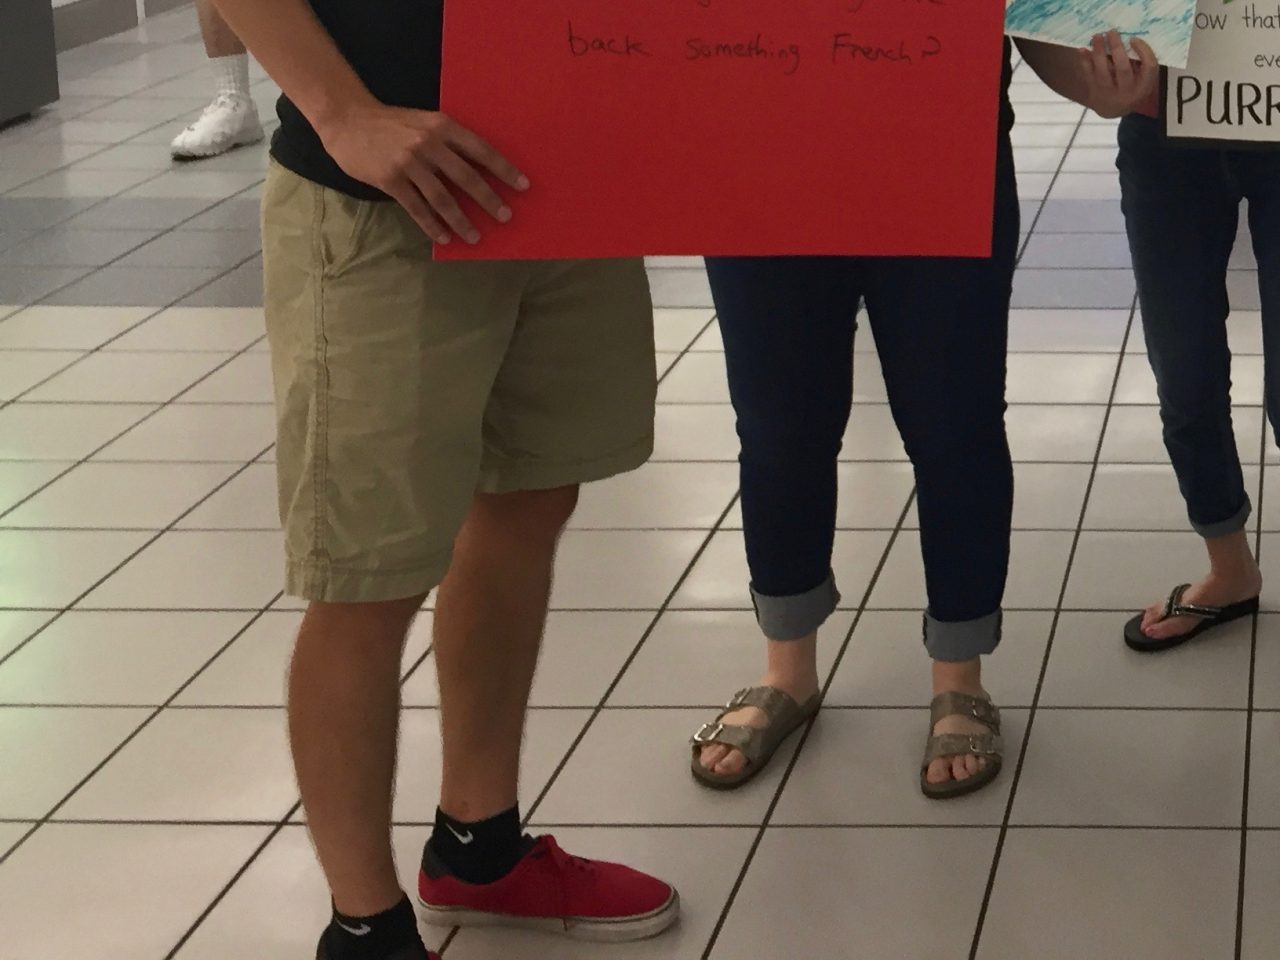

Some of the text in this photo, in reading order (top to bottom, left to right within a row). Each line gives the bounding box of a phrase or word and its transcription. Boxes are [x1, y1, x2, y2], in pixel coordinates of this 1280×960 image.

[1195, 13, 1228, 30] ow
[567, 20, 652, 57] back
[685, 33, 801, 75] something
